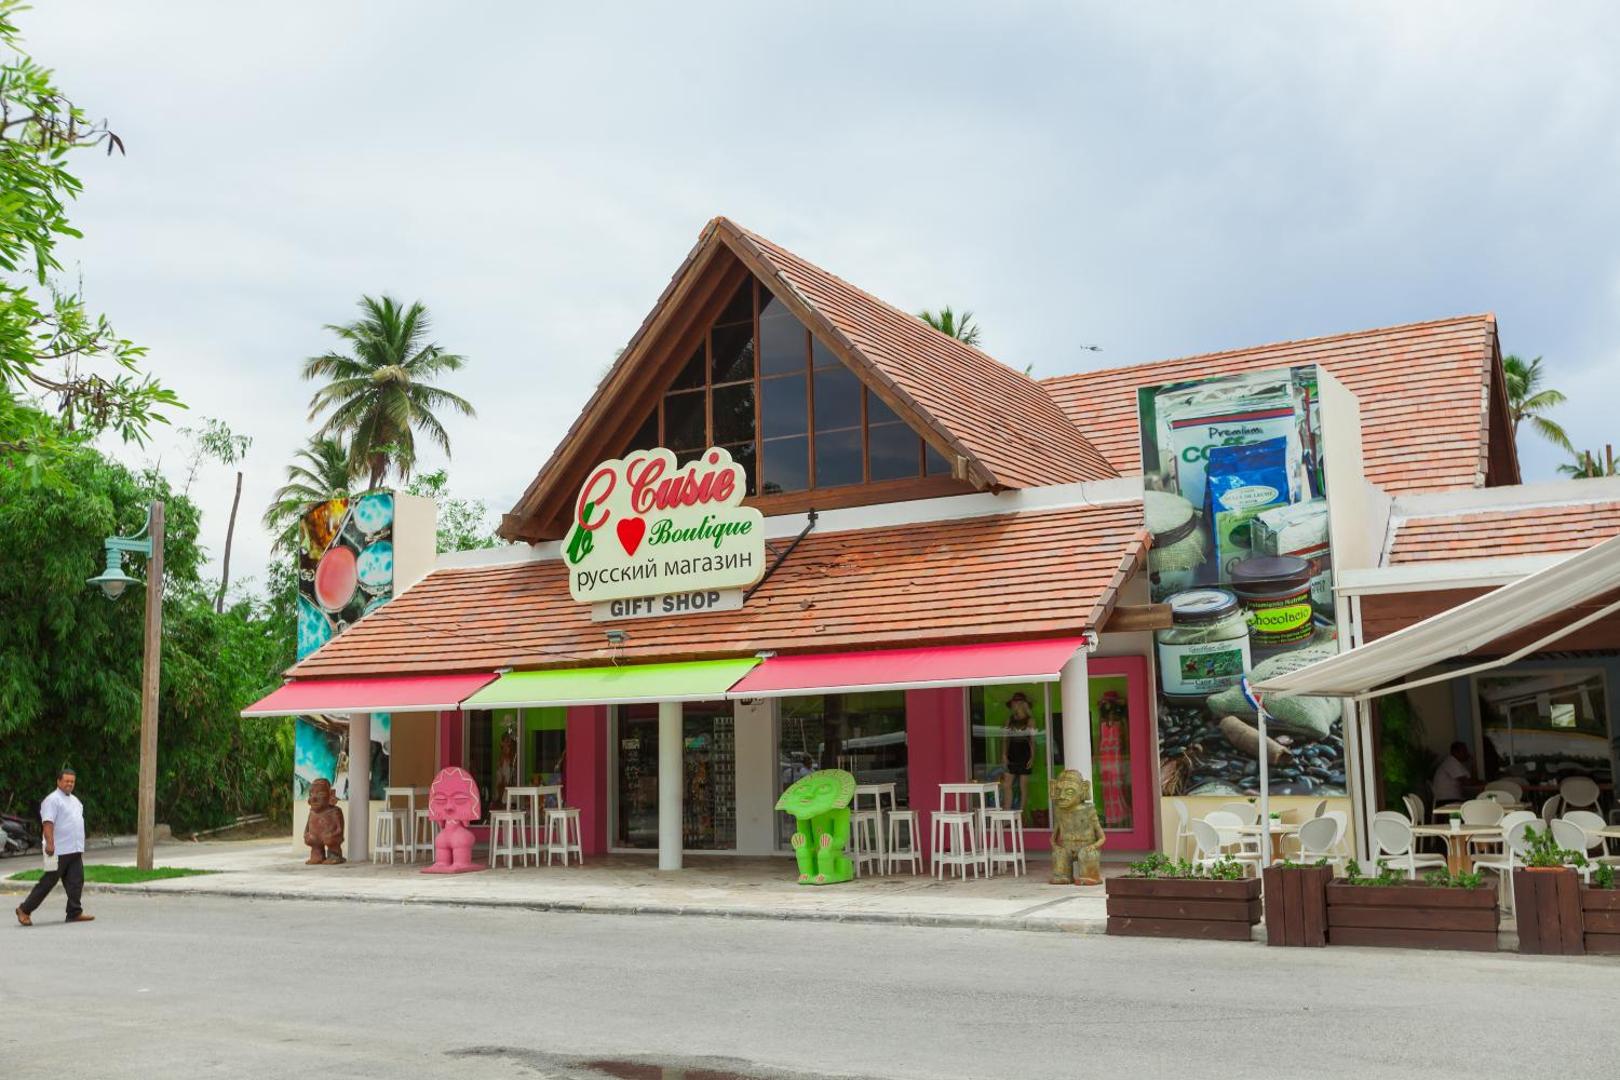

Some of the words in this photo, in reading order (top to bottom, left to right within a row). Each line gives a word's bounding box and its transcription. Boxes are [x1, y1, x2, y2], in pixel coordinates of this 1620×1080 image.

[1208, 426, 1263, 439] Premium
[626, 452, 735, 514] Cusie
[648, 515, 752, 549] Boutique
[577, 558, 657, 591] русский
[664, 552, 752, 577] магазин
[610, 597, 655, 617] GIFT
[662, 591, 720, 612] SHOP
